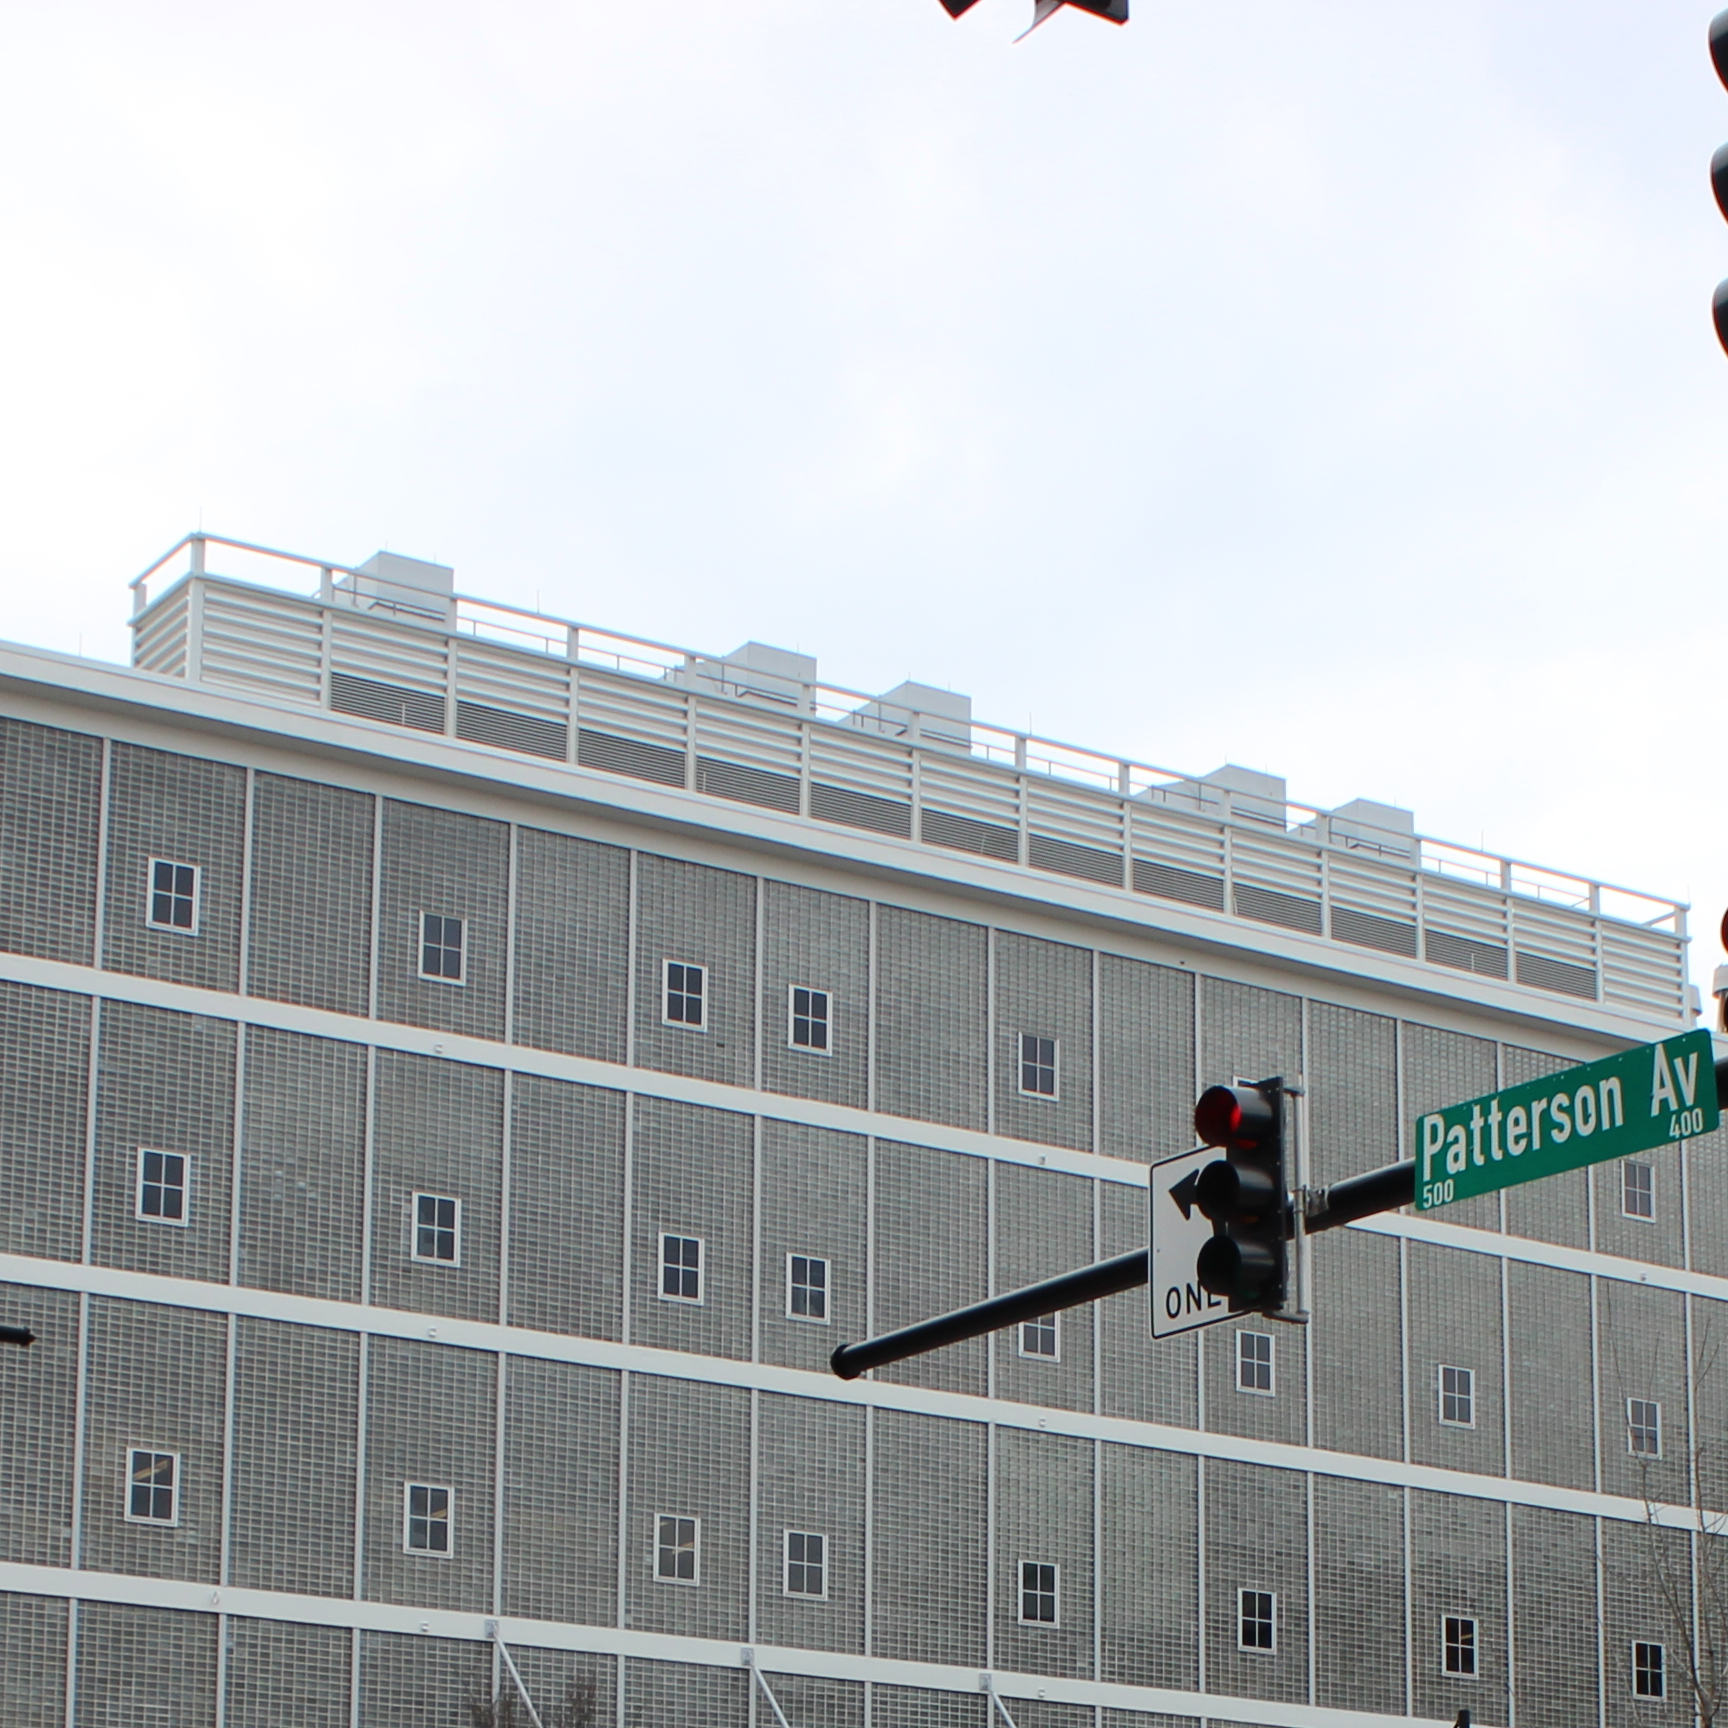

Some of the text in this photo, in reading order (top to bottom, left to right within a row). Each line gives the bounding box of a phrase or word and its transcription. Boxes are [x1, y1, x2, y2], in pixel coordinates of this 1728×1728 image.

[1422, 1042, 1699, 1183] Patterson Av
[1669, 1107, 1704, 1140] 400
[1422, 1178, 1455, 1209] 500
